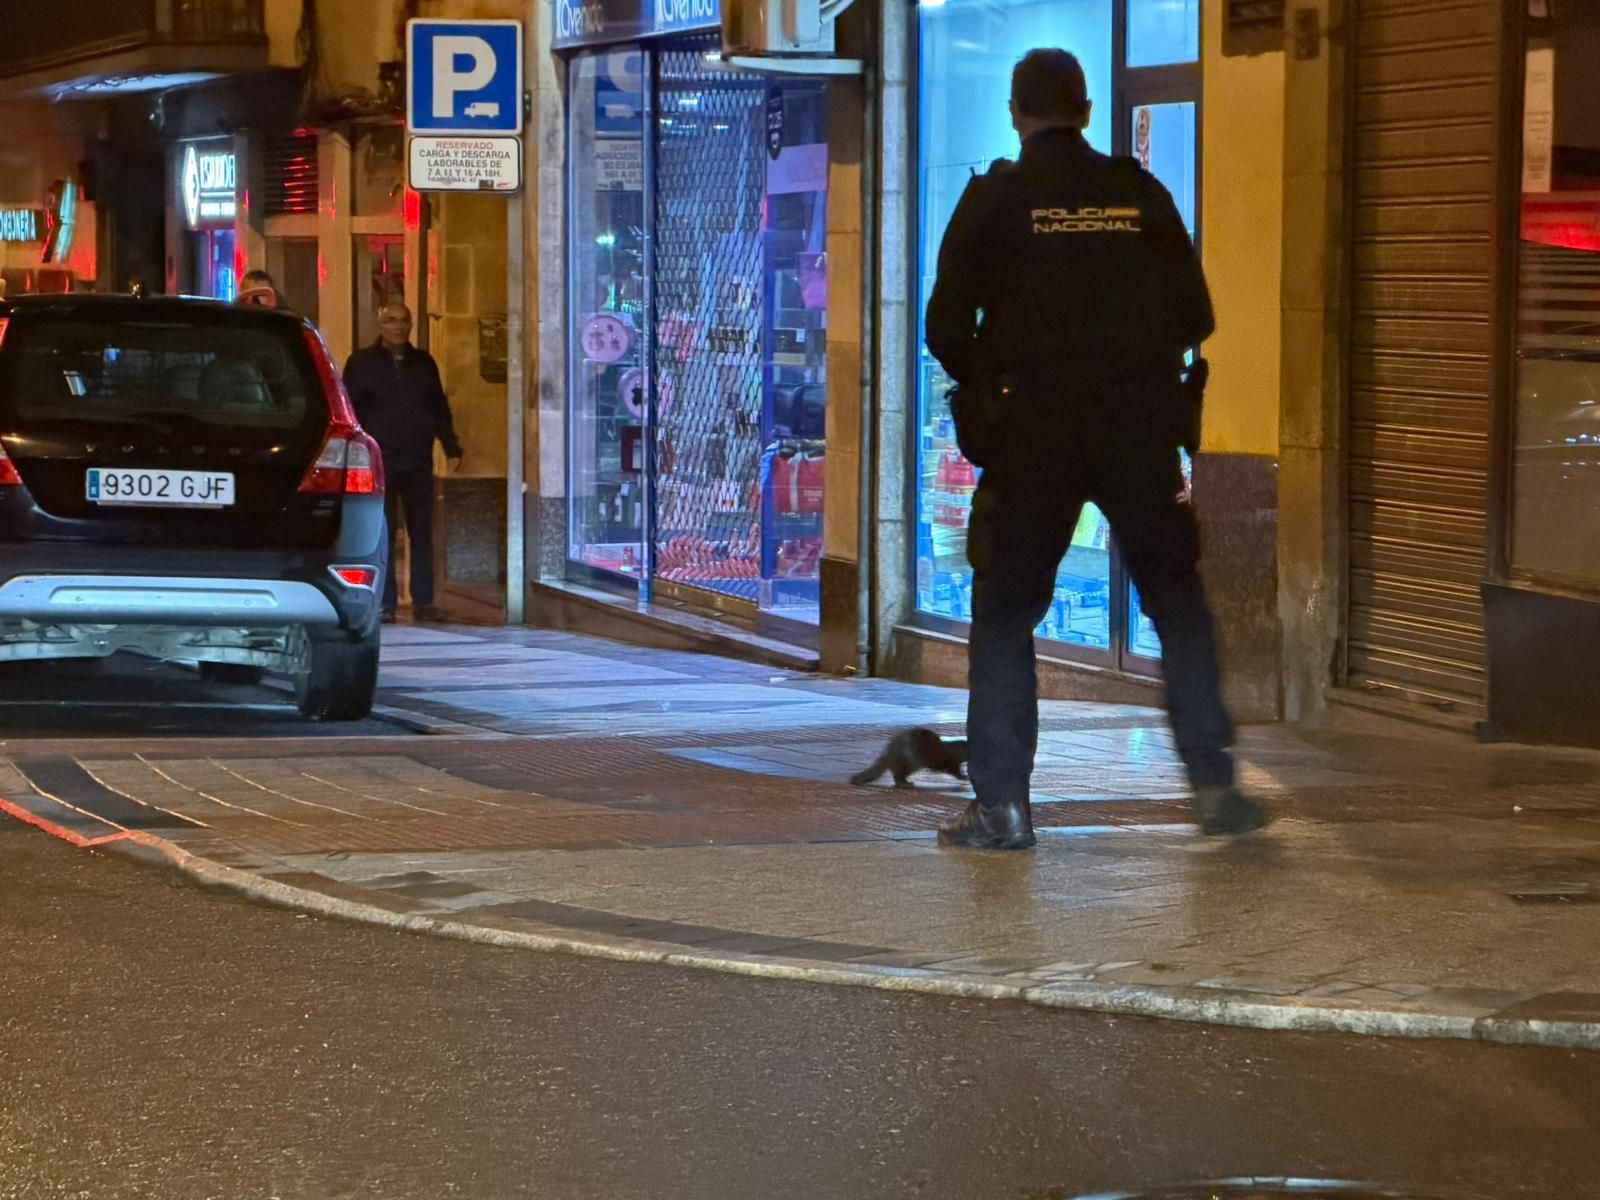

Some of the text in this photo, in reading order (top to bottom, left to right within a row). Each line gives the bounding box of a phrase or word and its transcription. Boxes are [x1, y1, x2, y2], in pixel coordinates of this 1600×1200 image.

[432, 35, 498, 118] P
[435, 141, 494, 150] RESERVADO
[419, 149, 511, 159] CARGA Y DESCARGA
[427, 159, 502, 168] LABORABLES DE
[427, 168, 433, 176] 7
[435, 168, 442, 176] A
[455, 169, 462, 177] Y
[475, 169, 482, 177] A
[1033, 221, 1142, 234] NACIONAL
[86, 444, 241, 455] VOVO
[105, 473, 228, 500] 9302 GJF
